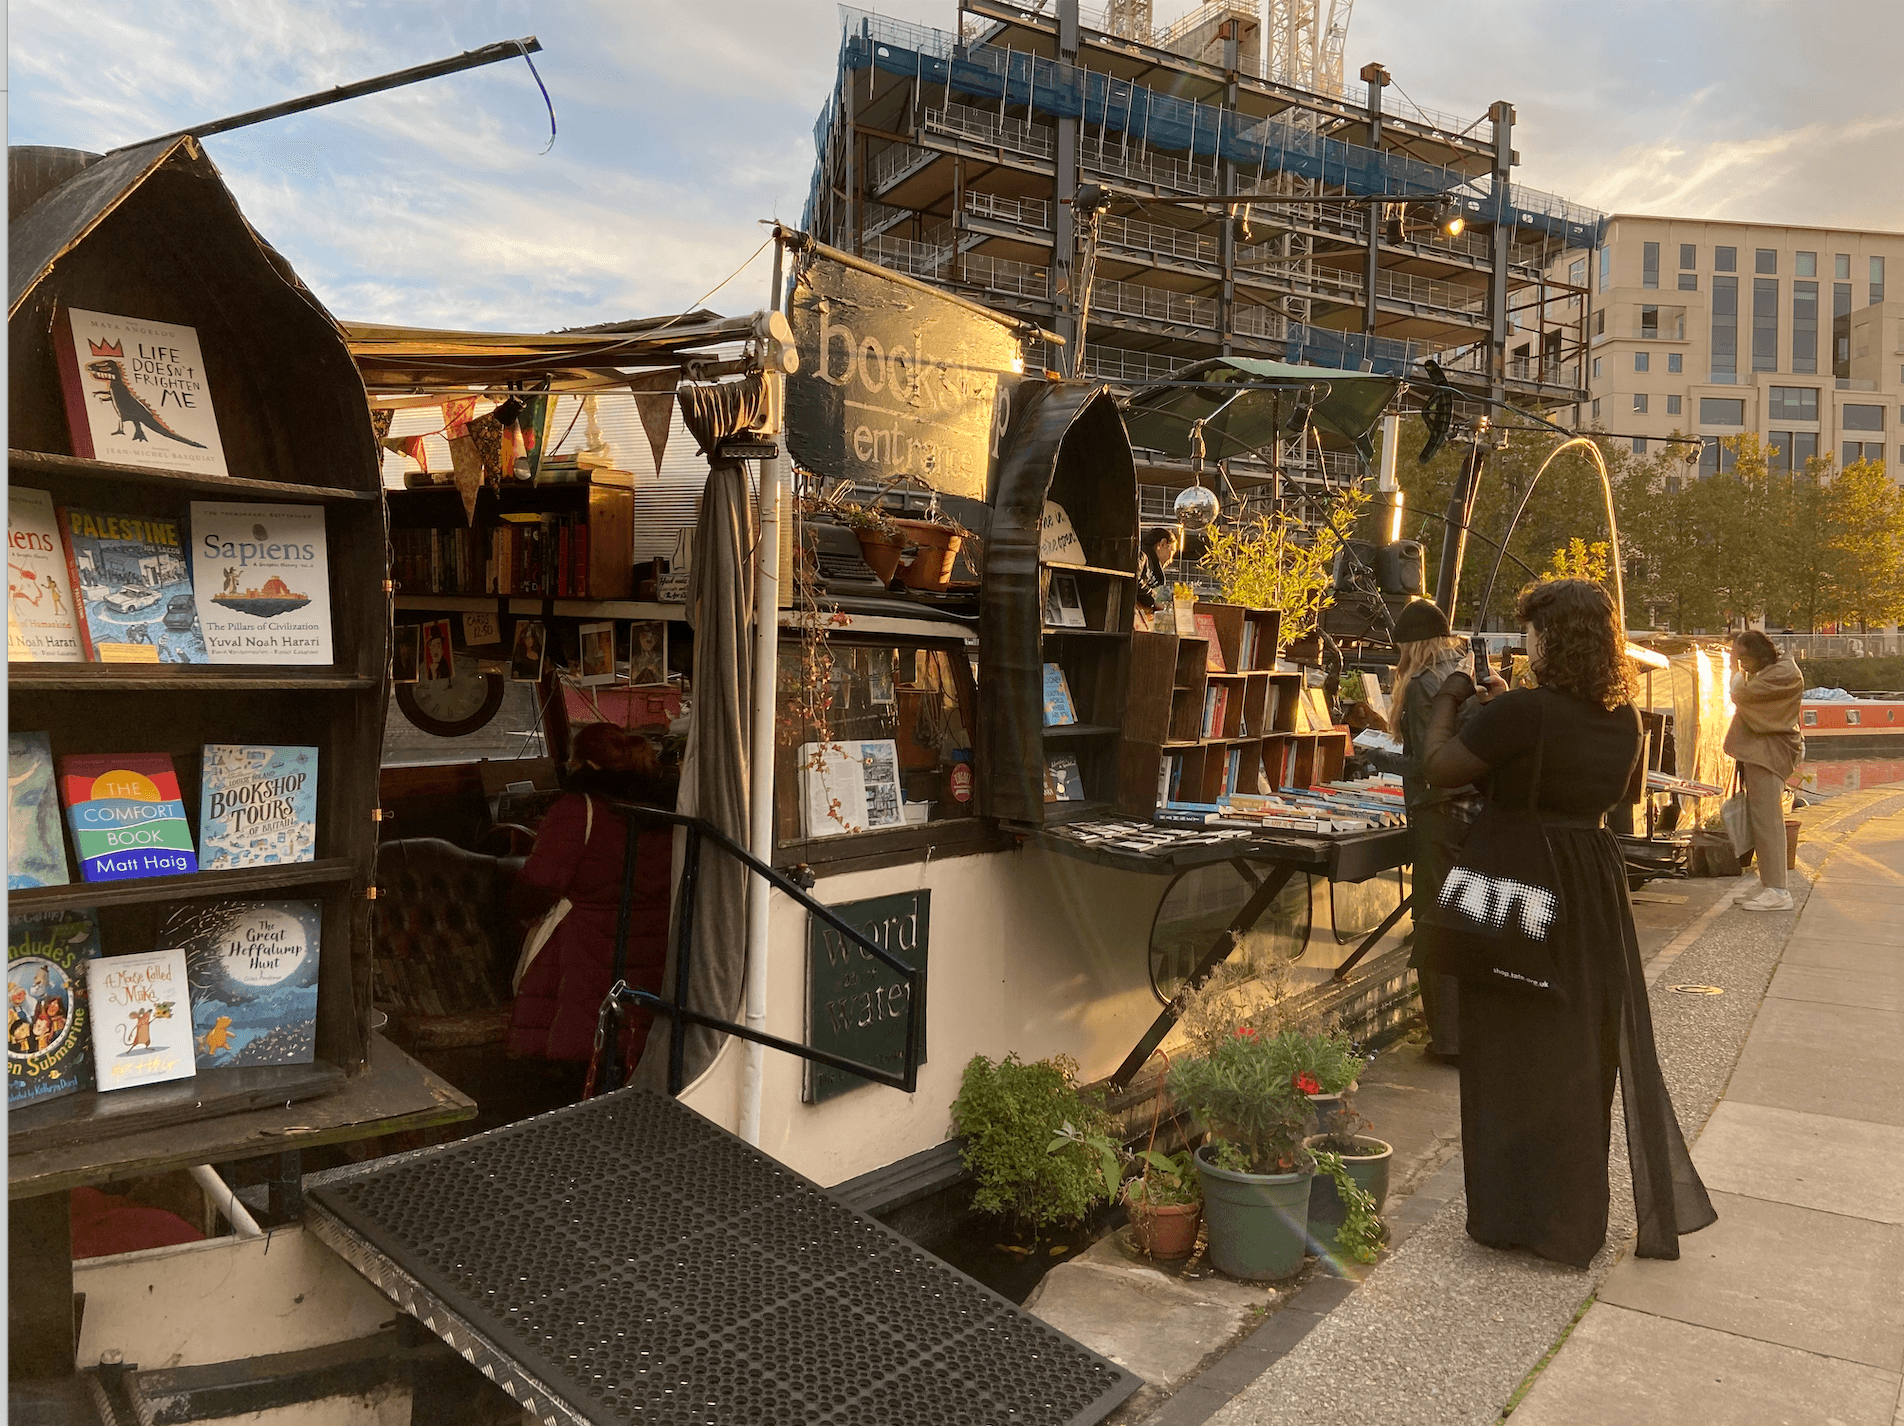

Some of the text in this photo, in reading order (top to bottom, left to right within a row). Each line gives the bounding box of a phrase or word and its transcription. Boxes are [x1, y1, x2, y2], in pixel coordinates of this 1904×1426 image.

[91, 321, 176, 338] MAYA ANGELOU
[138, 343, 180, 364] LIFE
[134, 373, 200, 391] FRIGHTEN
[161, 389, 197, 409] ME
[172, 452, 216, 462] BASQUIAT
[71, 513, 178, 546] PALESTINE
[8, 530, 53, 552] iens
[204, 534, 314, 567] Sapiens
[206, 621, 319, 631] The Pillars of Civilization
[16, 634, 43, 648] Noah
[47, 634, 77, 648] Harari
[208, 636, 319, 647] Yuval Noah Harari
[106, 782, 142, 796] THE
[209, 772, 306, 820] BOOKSHOP
[84, 804, 174, 822] COMFORT
[231, 796, 295, 833] TOURS
[249, 818, 295, 836] OF BRITAIN
[107, 829, 164, 846] BOOK
[96, 855, 187, 873] Matt Haig
[258, 920, 275, 931] The
[246, 928, 287, 942] Great
[8, 931, 76, 969] ndude's
[228, 941, 302, 957] Heffalump
[250, 957, 280, 969] Hunt
[103, 963, 172, 988] A Mouse Called
[27, 1007, 85, 1077] Submarine
